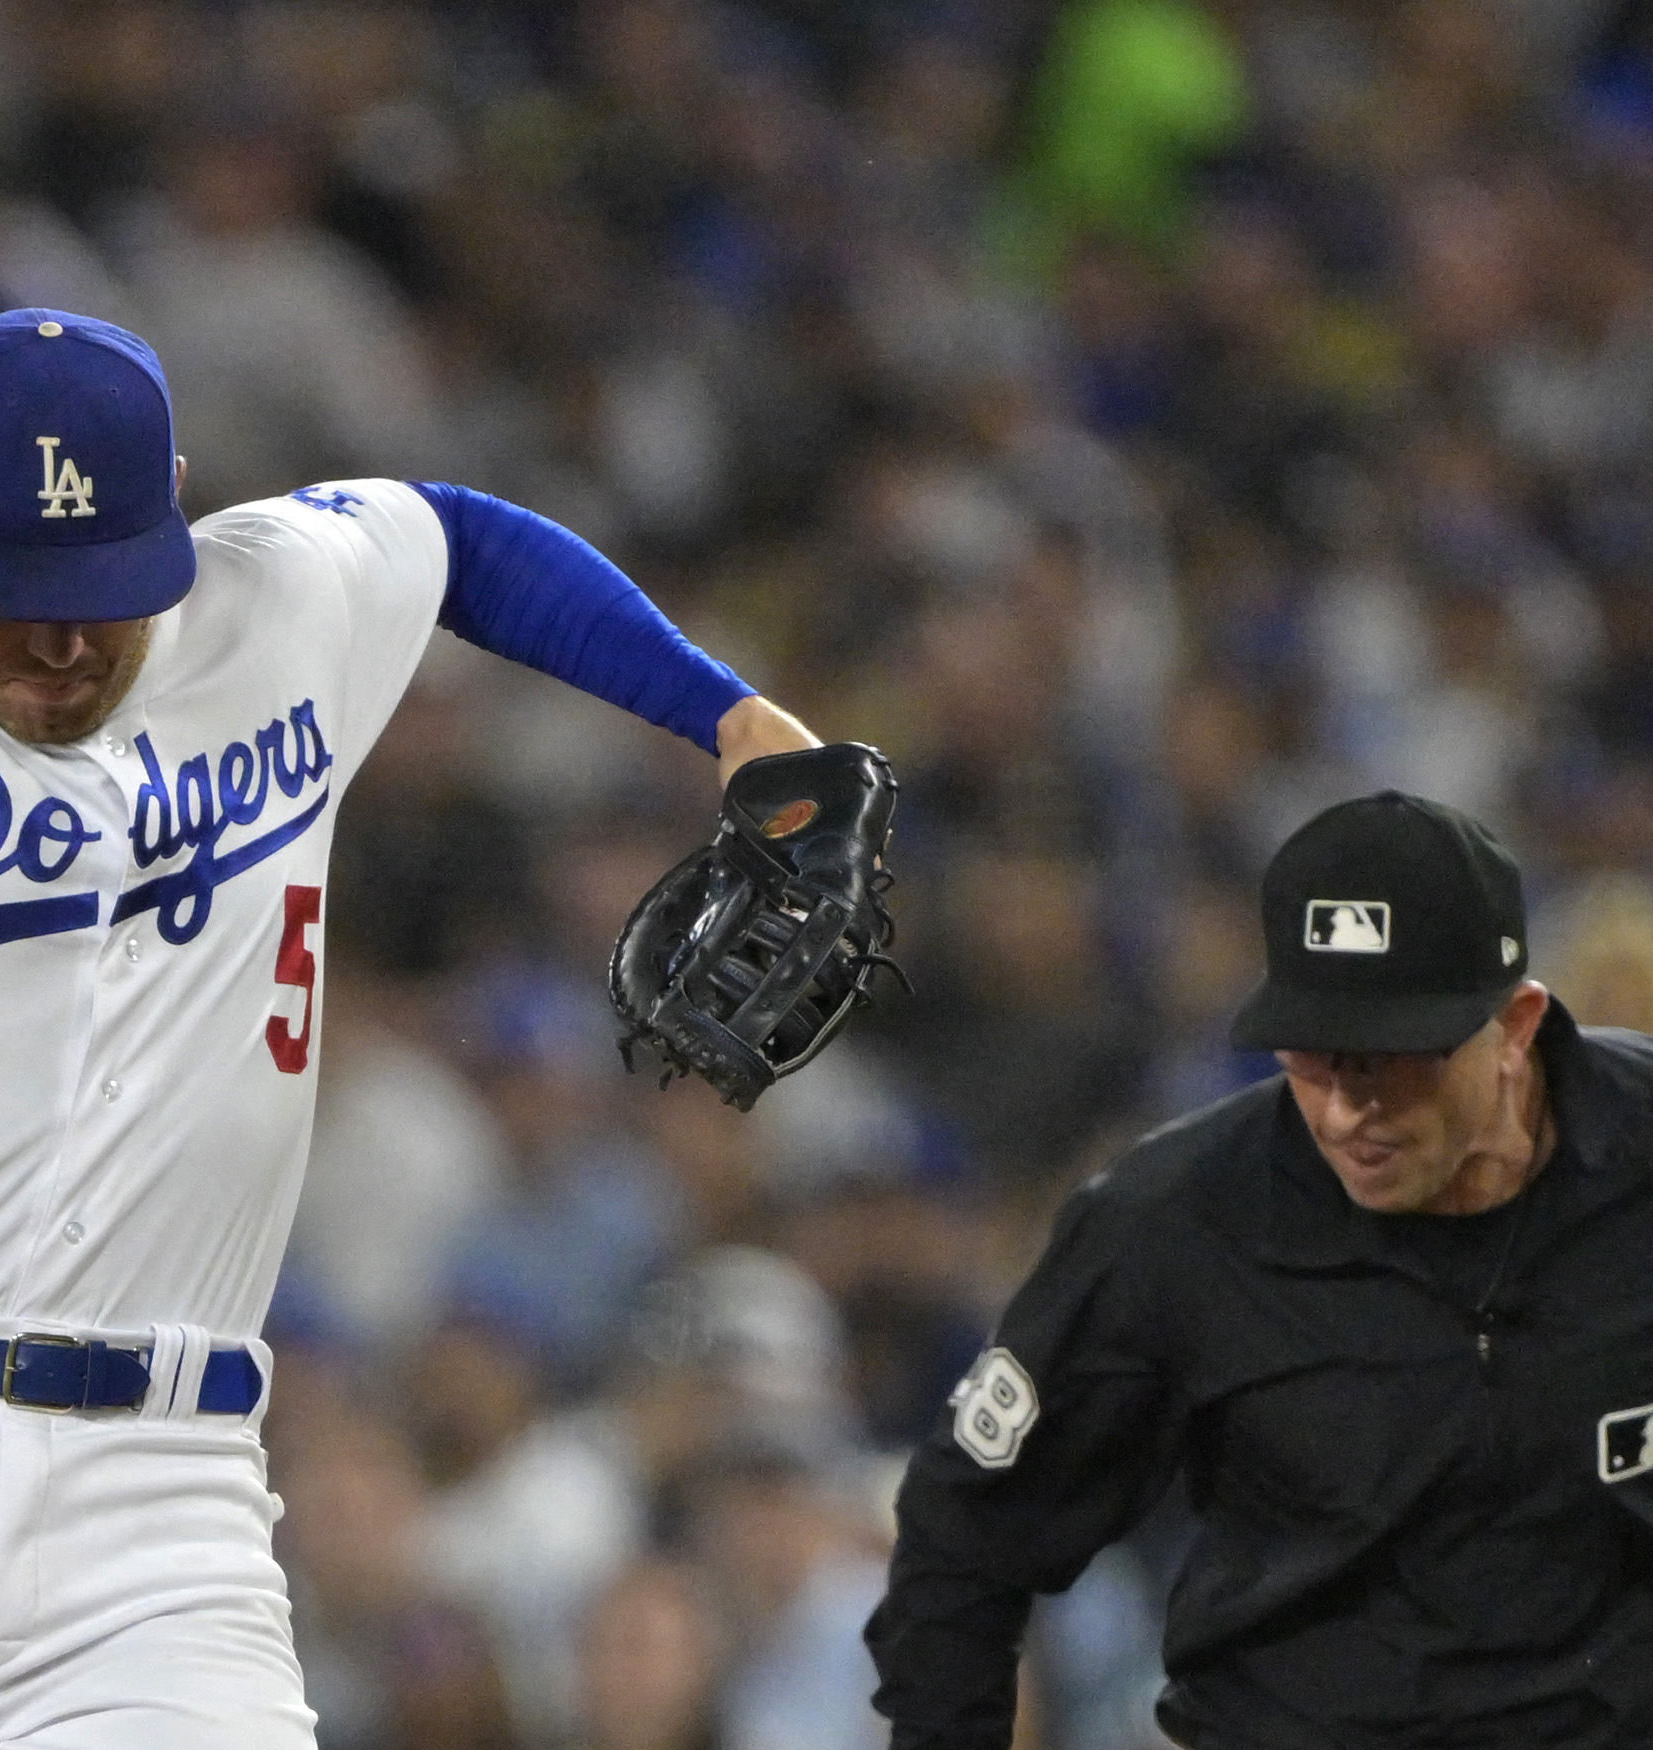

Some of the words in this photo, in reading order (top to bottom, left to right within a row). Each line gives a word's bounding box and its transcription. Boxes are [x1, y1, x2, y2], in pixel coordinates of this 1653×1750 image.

[36, 436, 96, 518] LA
[265, 885, 323, 1074] 5
[947, 1347, 1040, 1468] 8
